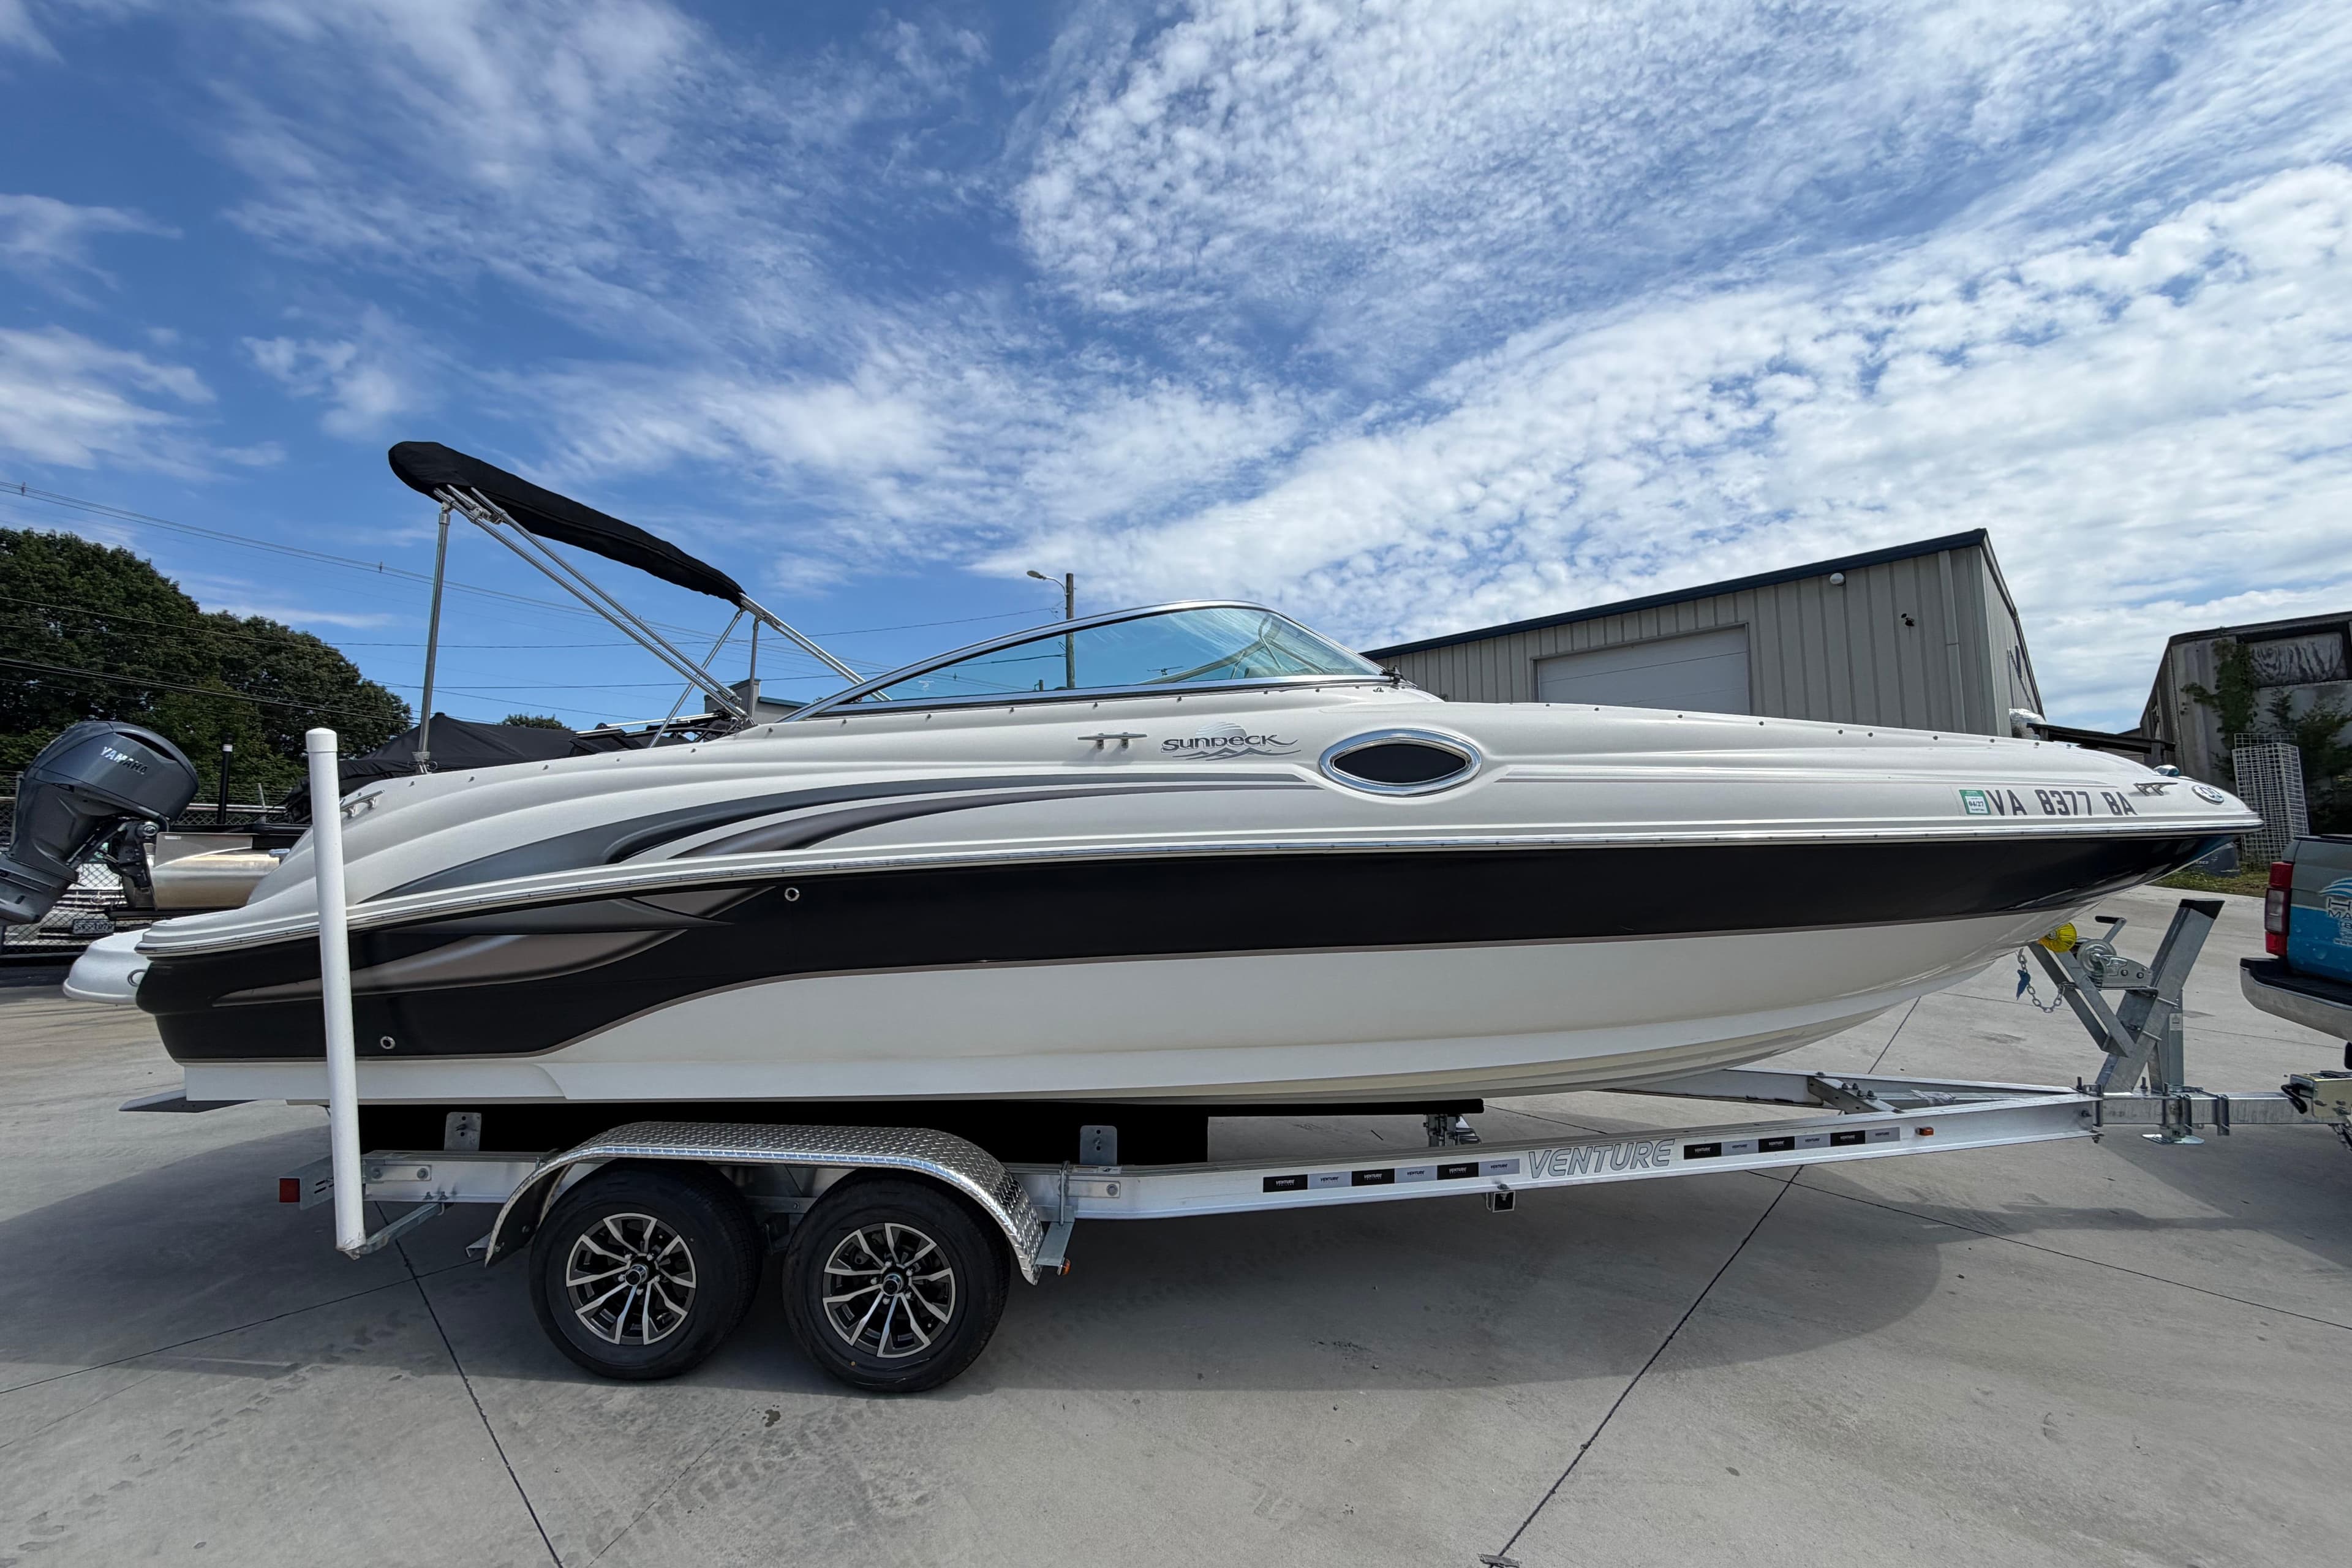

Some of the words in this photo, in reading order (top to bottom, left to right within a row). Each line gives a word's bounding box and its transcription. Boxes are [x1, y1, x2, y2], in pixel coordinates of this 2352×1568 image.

[1161, 734, 1298, 753] SUNDECK
[100, 747, 148, 774] YAMAHA
[1986, 790, 2027, 815] VA
[2035, 790, 2092, 815] 8377
[2100, 791, 2138, 815] BA
[1529, 1139, 1675, 1178] VENTURE
